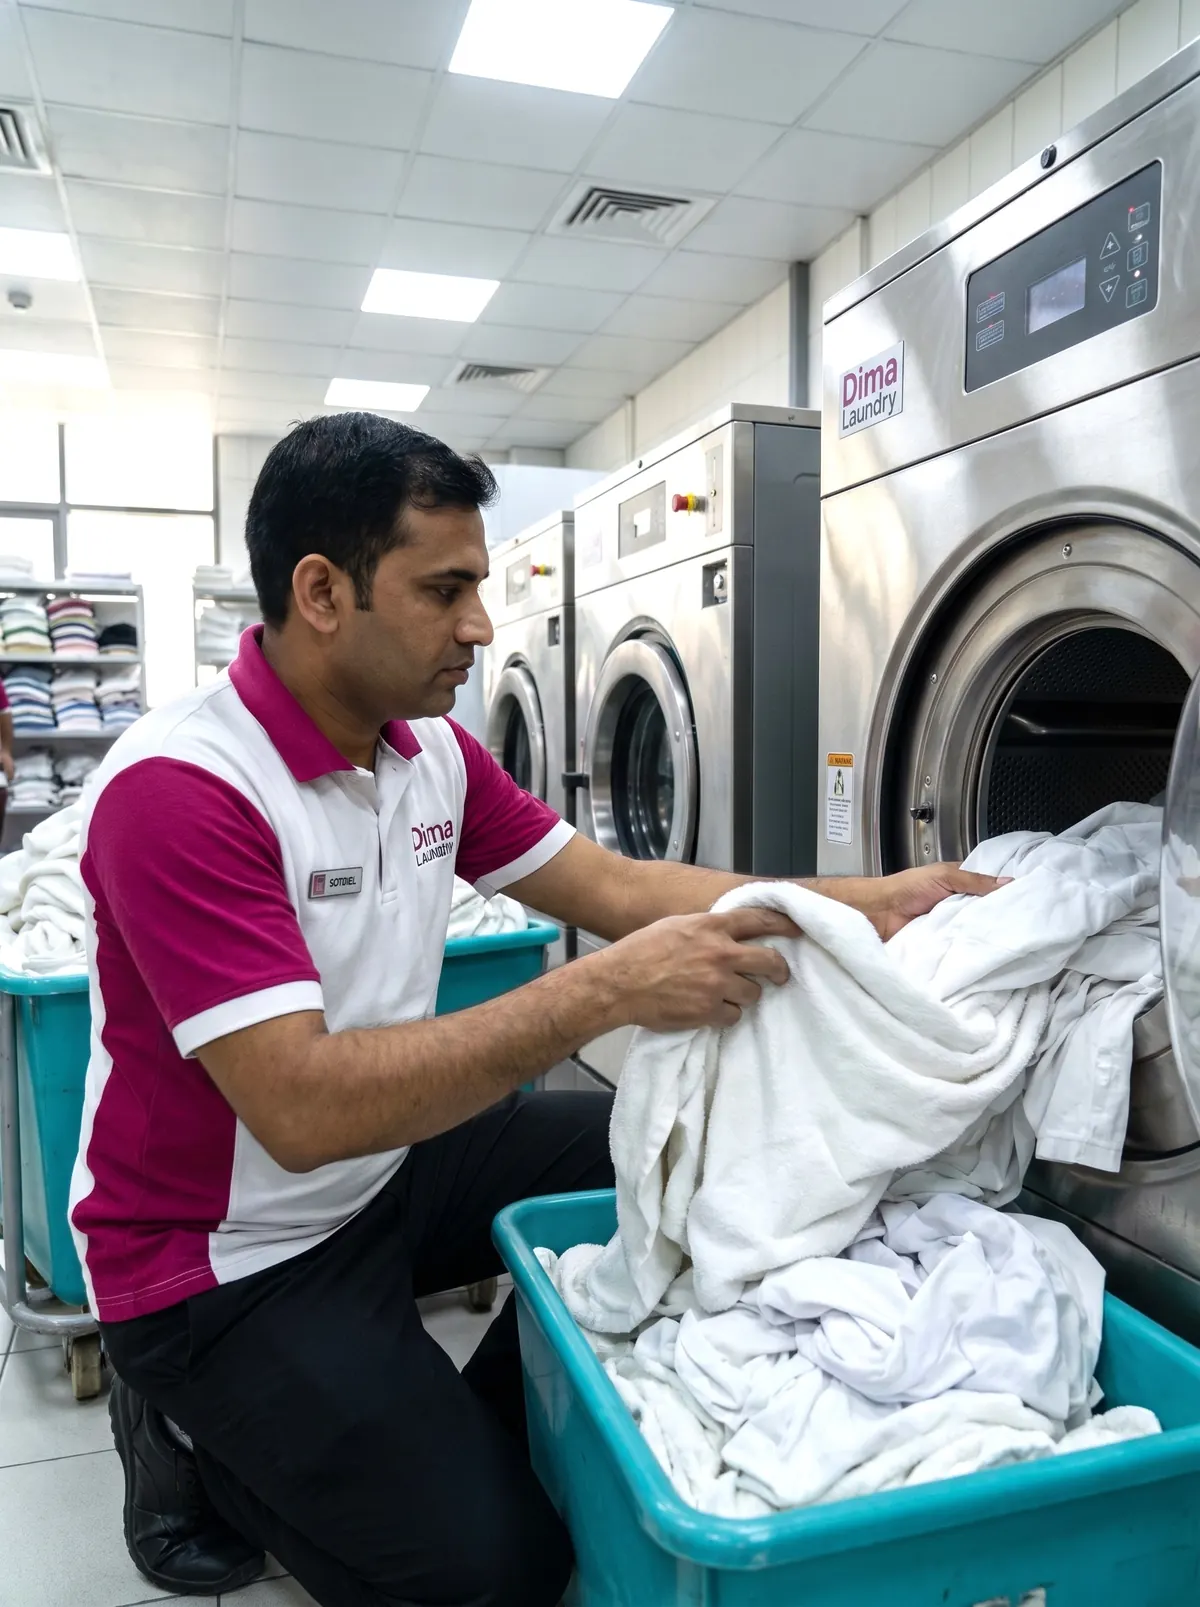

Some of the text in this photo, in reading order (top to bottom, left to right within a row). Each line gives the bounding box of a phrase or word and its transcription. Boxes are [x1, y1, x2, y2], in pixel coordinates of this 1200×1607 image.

[843, 358, 897, 408] Dima
[842, 391, 897, 430] Laundry
[411, 819, 453, 852] Dima
